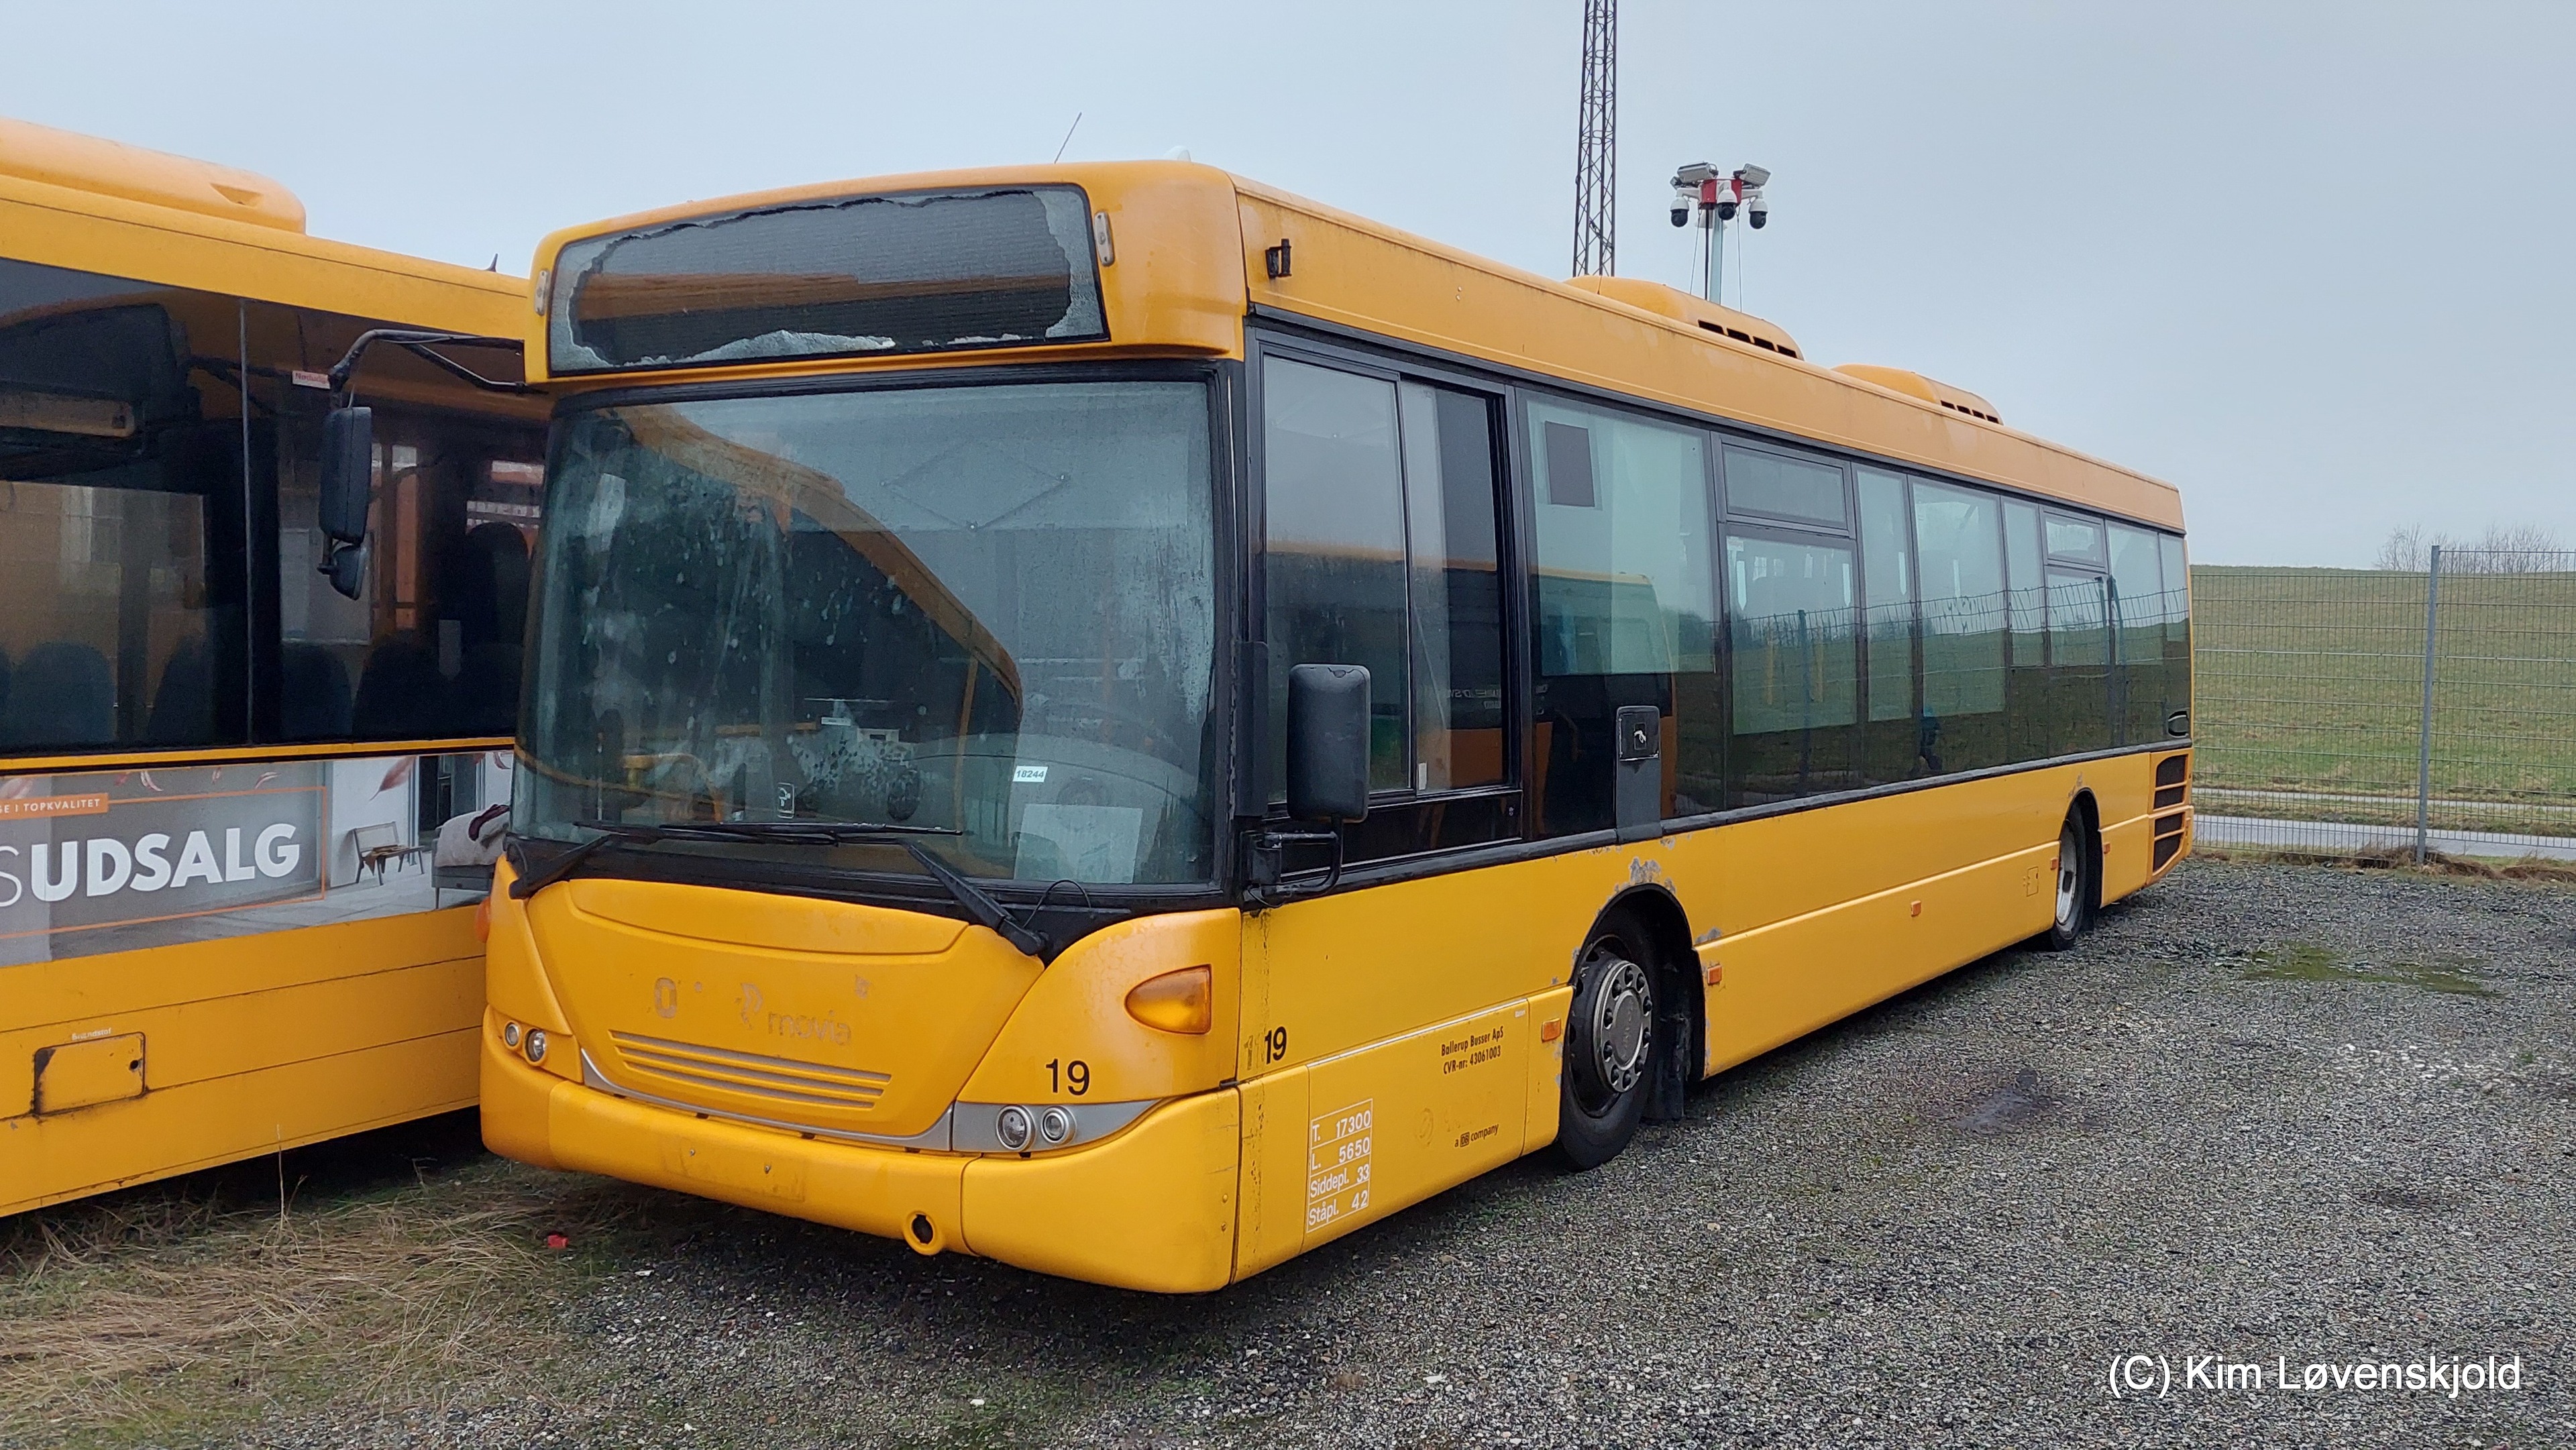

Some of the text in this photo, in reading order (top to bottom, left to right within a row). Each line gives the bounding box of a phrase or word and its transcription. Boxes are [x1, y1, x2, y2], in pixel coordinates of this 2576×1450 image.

[1016, 770, 1044, 778] 18244
[23, 799, 101, 812] TOPKVALITET
[1265, 1026, 1287, 1065] 19
[1441, 1025, 1503, 1056] Ballerup Busser ApS
[1444, 1045, 1501, 1074] CVR-nr: 43061003
[1045, 1058, 1089, 1096] 19
[1312, 1110, 1371, 1142] T. 17300
[1454, 1139, 1459, 1148] a
[1470, 1123, 1499, 1141] company
[1311, 1137, 1371, 1171] L. 5650
[1310, 1164, 1370, 1198] Siddepl. 33
[1309, 1190, 1368, 1226] Ståpl. 42
